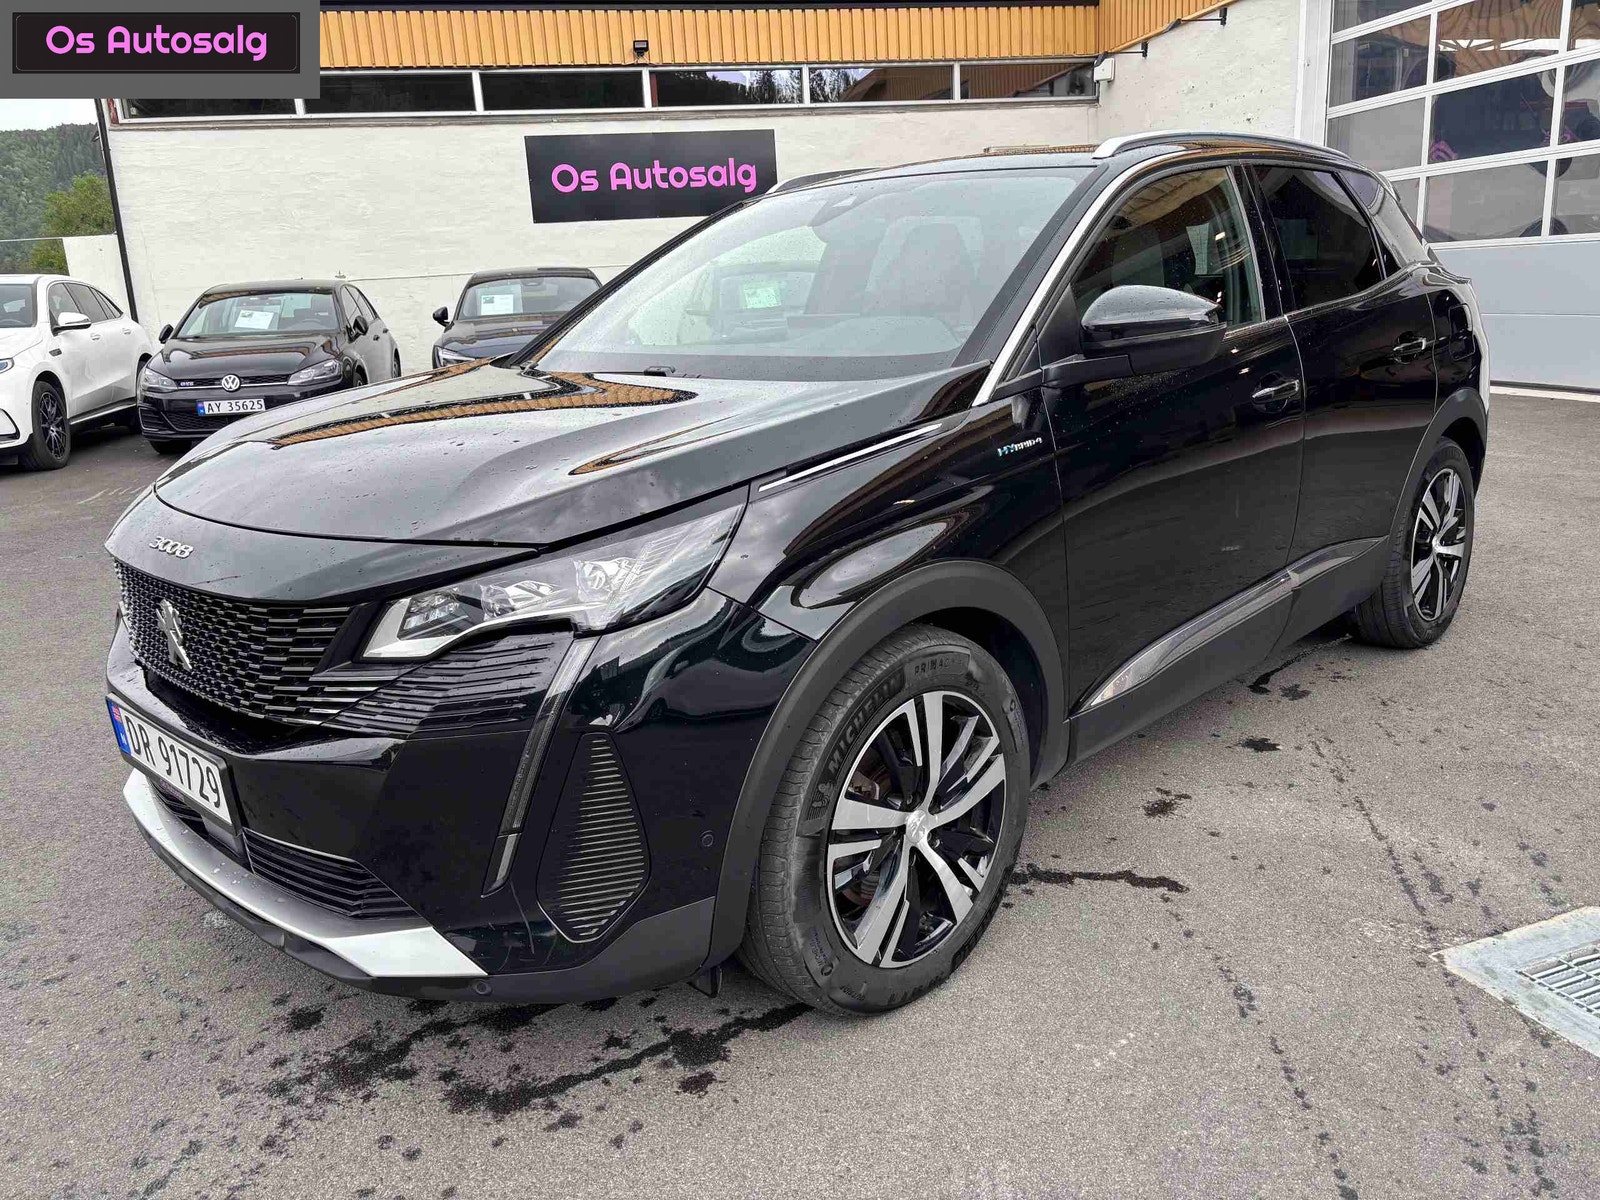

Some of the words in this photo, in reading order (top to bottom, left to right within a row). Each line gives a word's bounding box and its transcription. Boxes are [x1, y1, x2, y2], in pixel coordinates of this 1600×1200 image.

[551, 163, 599, 193] Os
[610, 157, 757, 193] Autosalg
[207, 402, 224, 413] AY
[227, 400, 263, 412] 35625
[149, 535, 194, 559] 3008
[124, 715, 156, 767] DR
[158, 736, 220, 808] 91729
